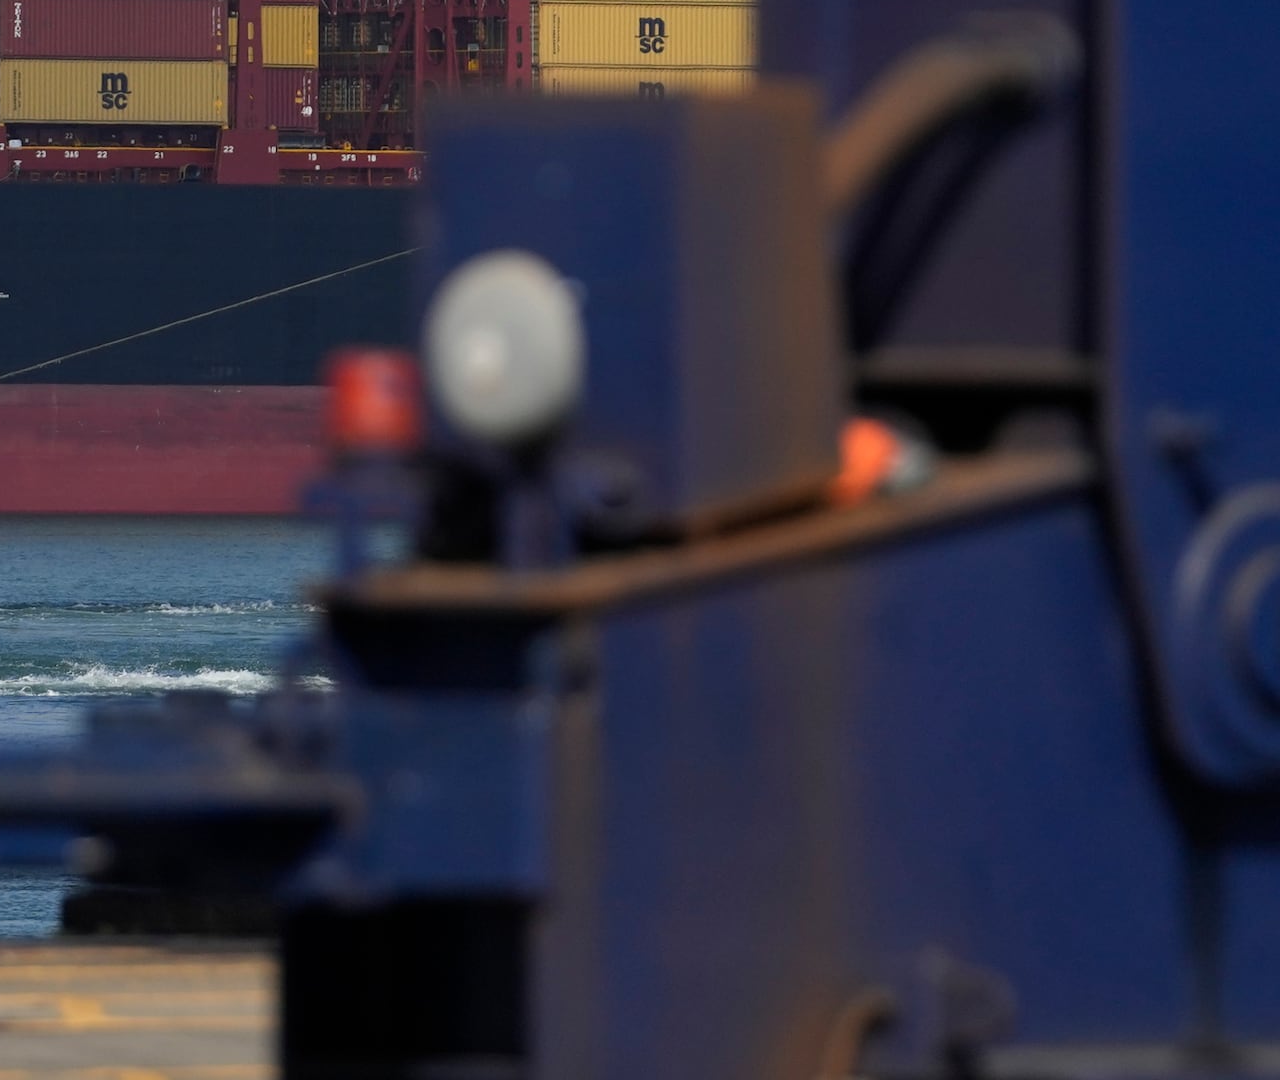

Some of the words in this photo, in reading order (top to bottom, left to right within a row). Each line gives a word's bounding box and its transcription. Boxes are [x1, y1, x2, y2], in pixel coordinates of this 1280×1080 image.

[223, 146, 235, 154] 22
[97, 151, 108, 159] 22
[154, 151, 165, 159] 21
